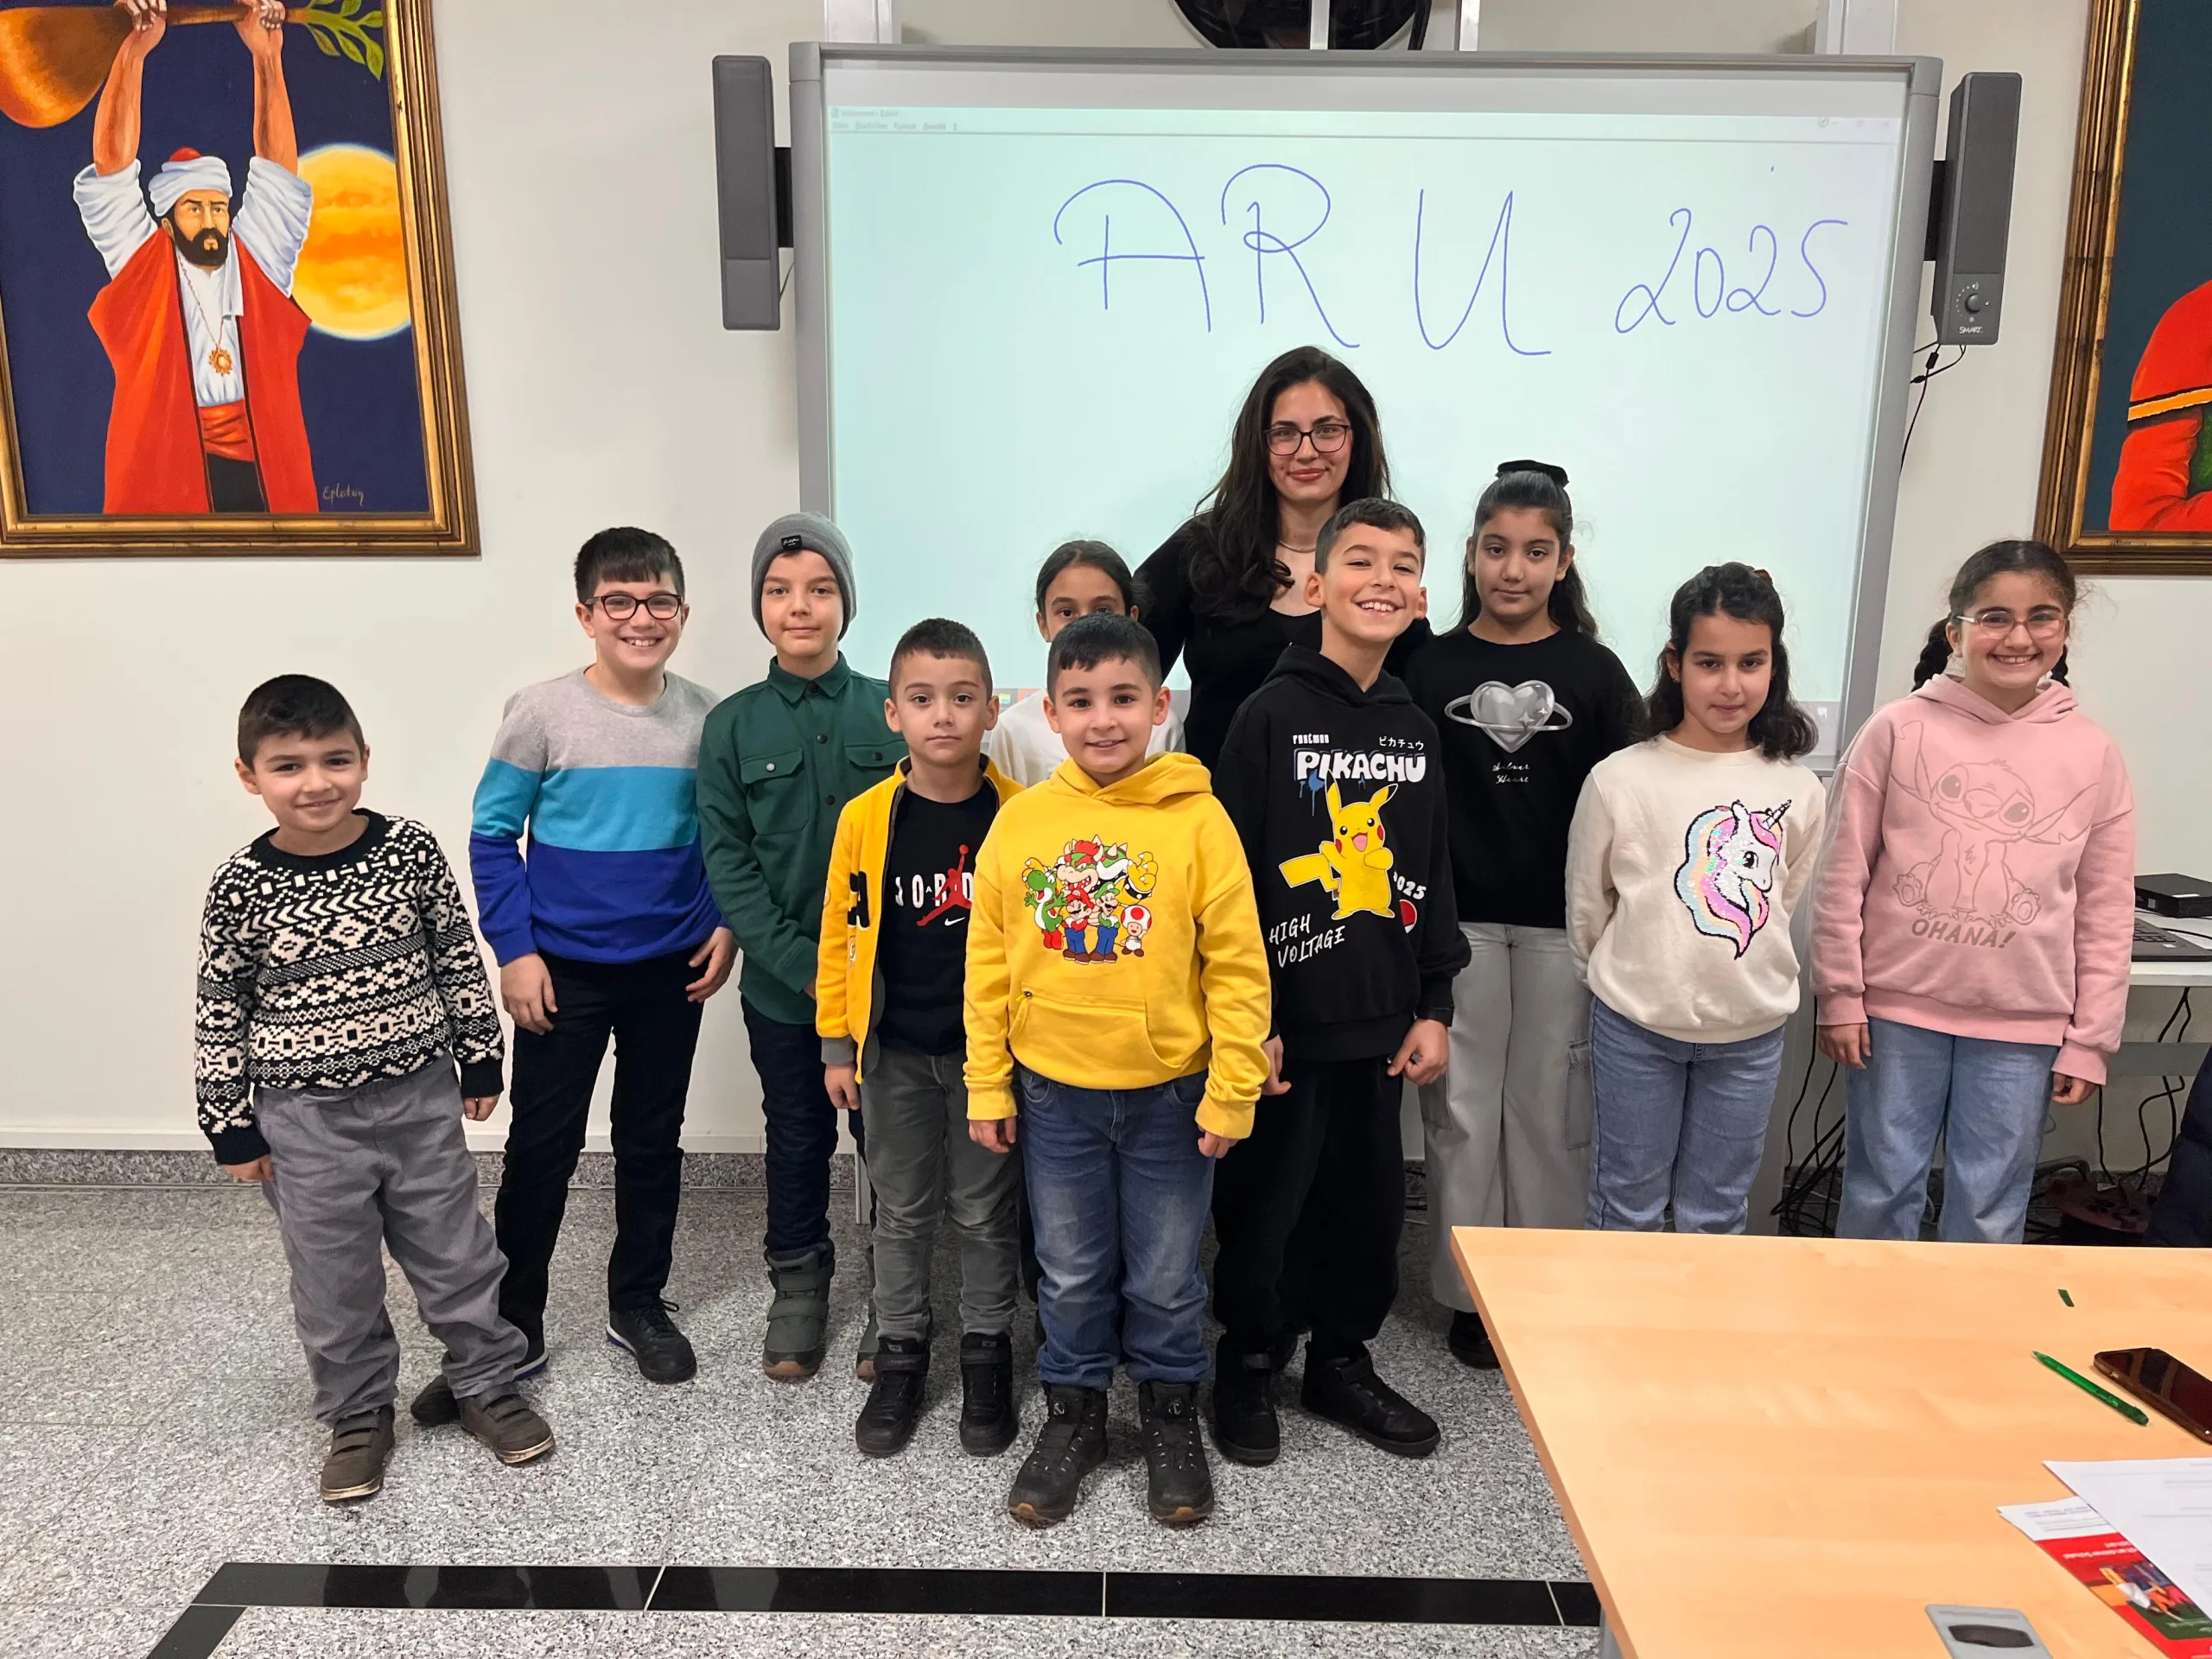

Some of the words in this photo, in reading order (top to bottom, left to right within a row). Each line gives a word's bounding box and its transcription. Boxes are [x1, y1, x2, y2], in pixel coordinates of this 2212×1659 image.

[1616, 208, 1848, 334] 2025
[1959, 326, 1983, 334] SMART
[1379, 736, 1424, 750] ピカチュウ
[1294, 748, 1426, 782] PIKACHU
[1393, 871, 1427, 900] 025
[1269, 913, 1311, 944] HIGH
[1911, 918, 2017, 949] OHANA!
[1277, 925, 1345, 968] VOLTAGE
